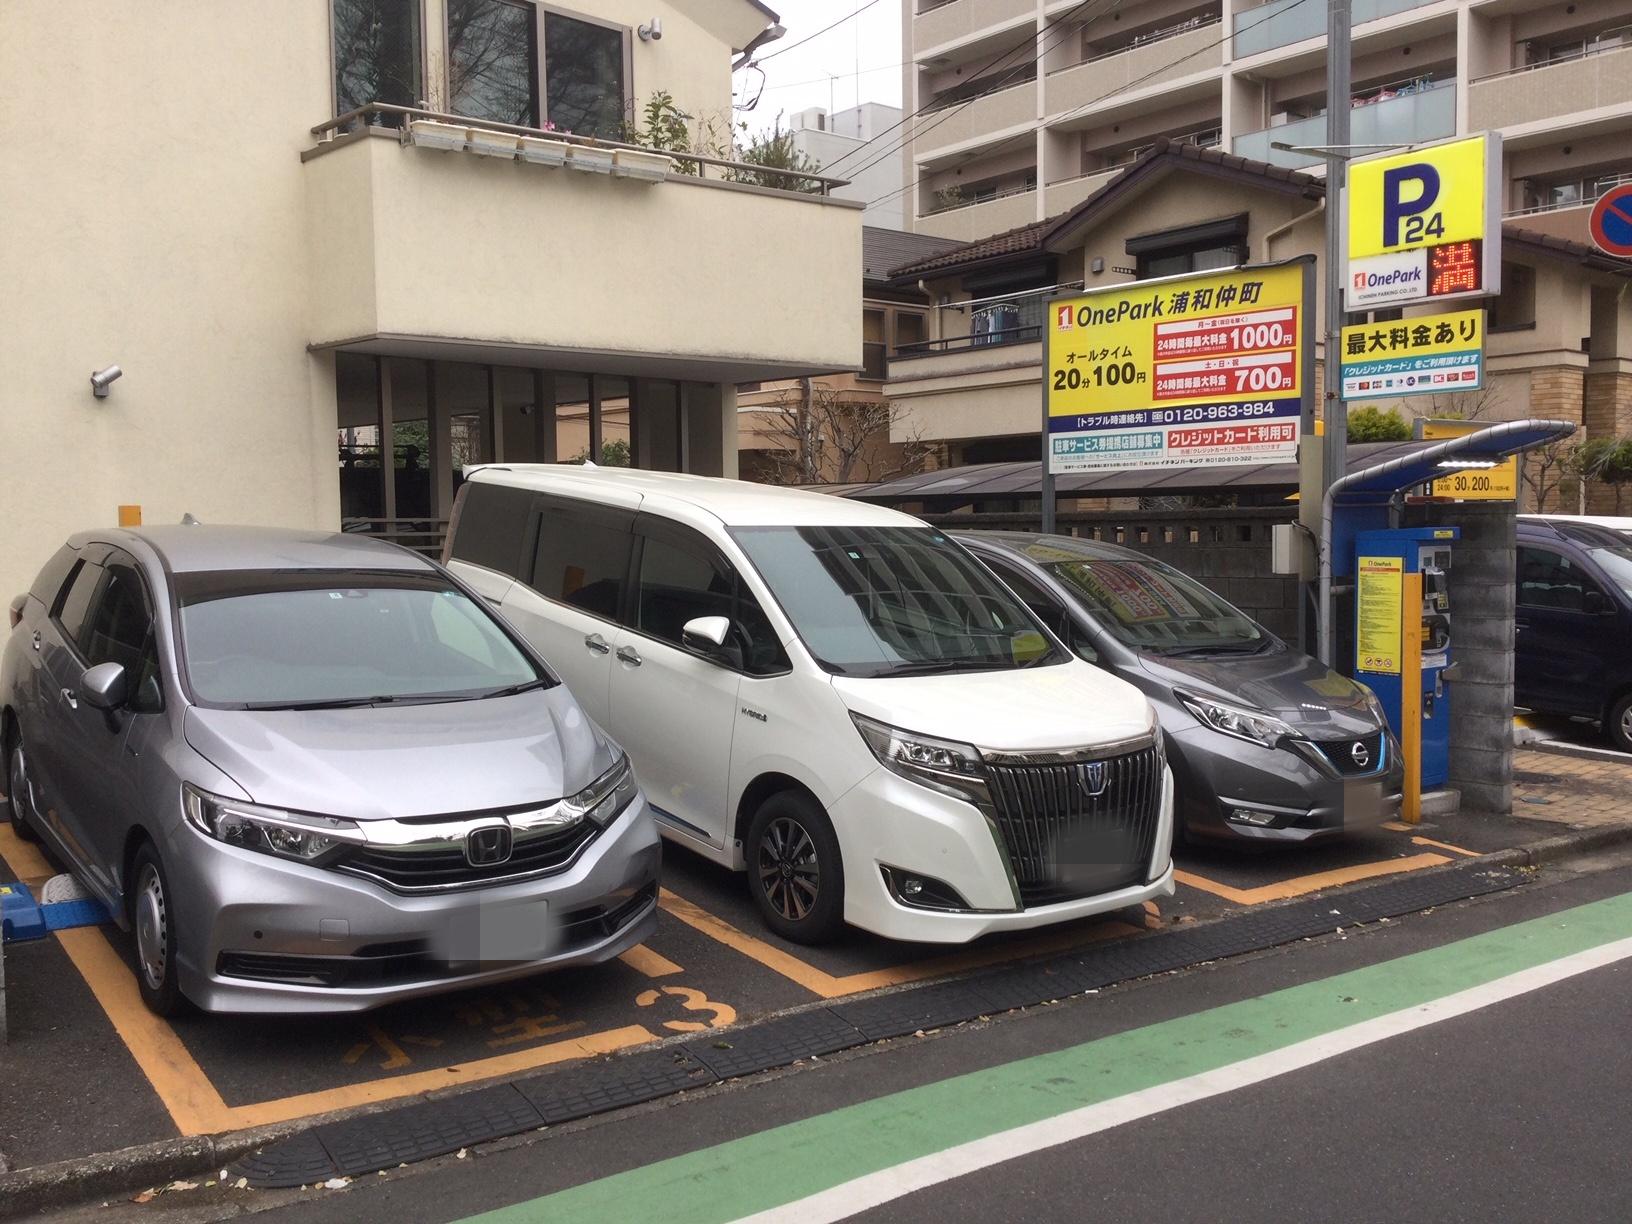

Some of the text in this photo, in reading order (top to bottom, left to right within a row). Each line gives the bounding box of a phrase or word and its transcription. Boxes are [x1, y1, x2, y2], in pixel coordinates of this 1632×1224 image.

[1383, 163, 1440, 247] P
[1405, 212, 1445, 244] 24
[1368, 266, 1421, 287] OnePark
[1432, 243, 1475, 294] 満
[1076, 295, 1165, 328] OnePark
[1167, 281, 1264, 315] 浦和仲町
[1230, 323, 1293, 350] 1000円
[1347, 319, 1476, 355] 最大料金あり
[1066, 345, 1133, 364] オールタイム
[1234, 366, 1292, 392] 700円
[1164, 401, 1275, 422] 0120-963-984
[1170, 425, 1293, 446] クレジットカード利用可
[635, 985, 737, 1032] 3
